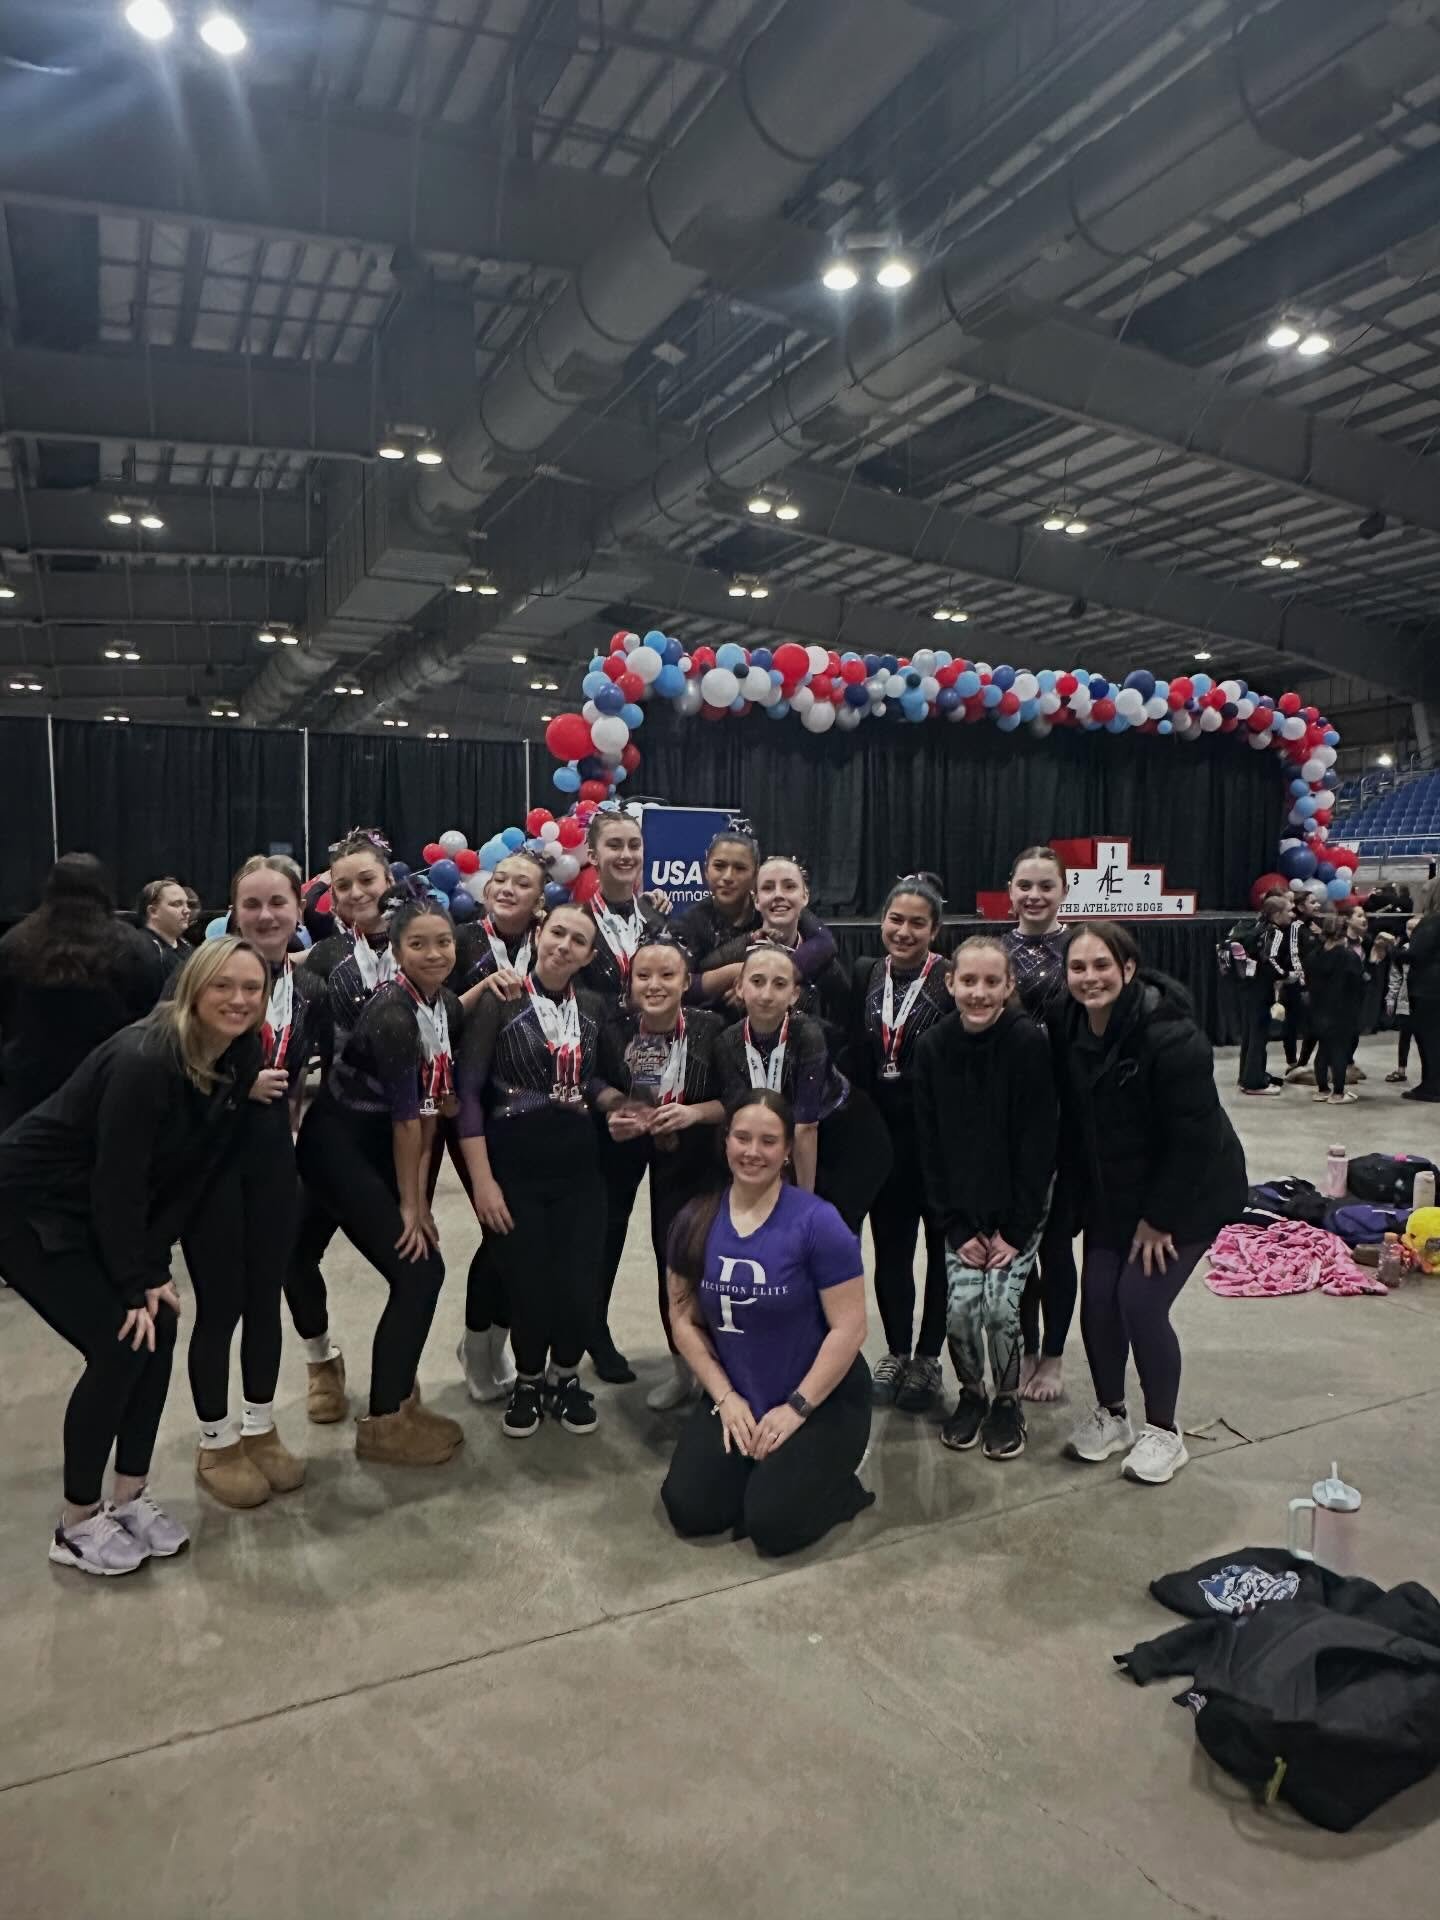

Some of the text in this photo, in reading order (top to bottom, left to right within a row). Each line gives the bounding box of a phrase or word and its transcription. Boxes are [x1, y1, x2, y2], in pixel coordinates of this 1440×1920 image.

[1110, 846, 1115, 859] 1
[652, 861, 703, 885] USA
[1073, 872, 1079, 885] 3
[1144, 873, 1150, 885] 2
[1059, 903, 1163, 912] THE ATHLETIC EDGE
[1176, 898, 1183, 911] 4
[717, 1256, 766, 1333] P
[752, 1286, 789, 1296] ELITE
